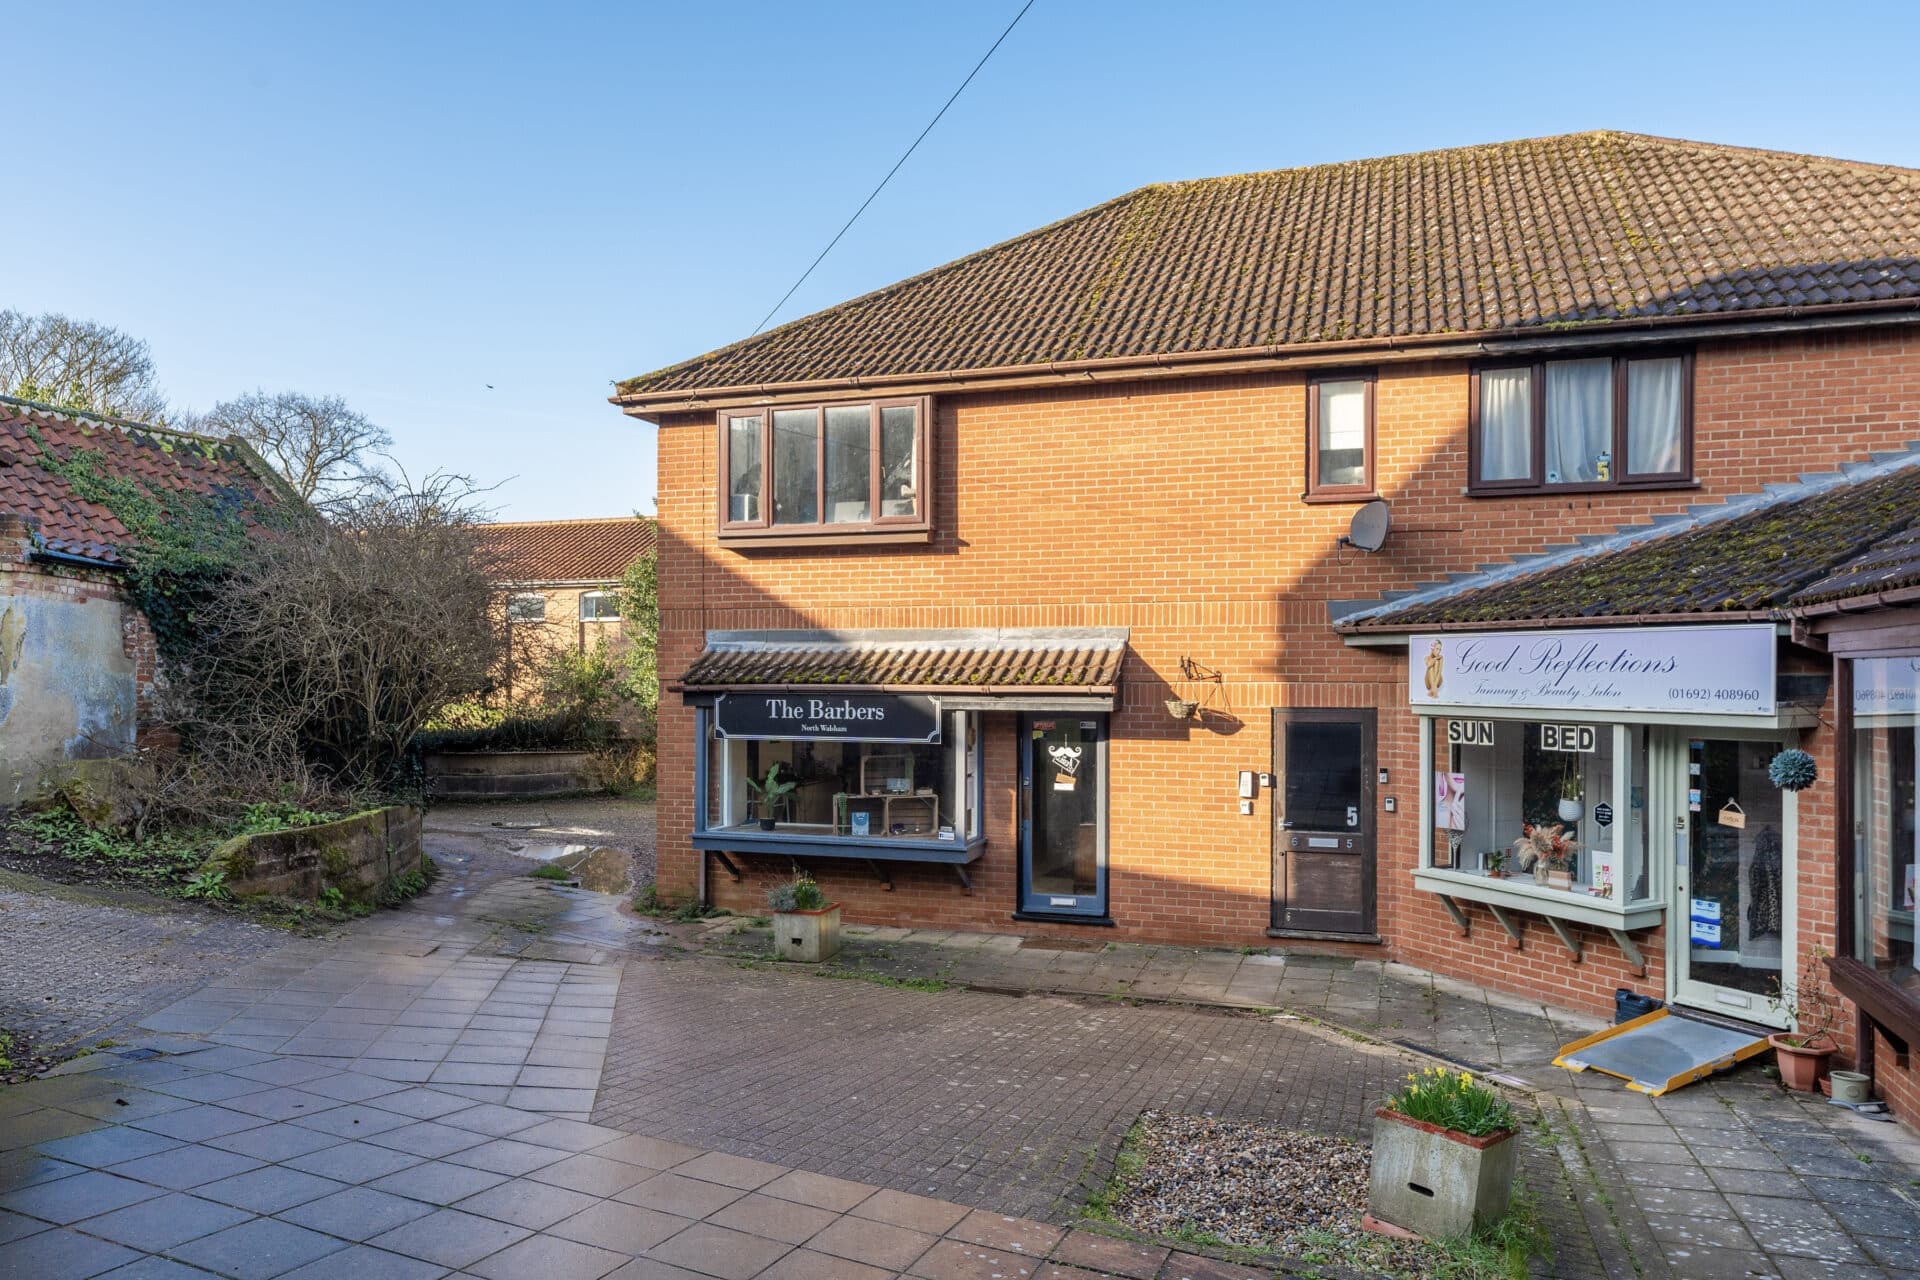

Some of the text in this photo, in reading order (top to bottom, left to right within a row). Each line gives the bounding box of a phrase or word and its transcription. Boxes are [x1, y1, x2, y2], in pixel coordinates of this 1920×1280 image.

[1455, 637, 1678, 687] Good Reflections
[1471, 678, 1518, 699] Tanning
[1531, 678, 1580, 703] Beauty
[1582, 680, 1623, 698] Salon
[1668, 688, 1760, 702] (01692) 408960
[766, 699, 885, 720] The Barbers
[801, 724, 847, 732] North Walsham
[1449, 721, 1594, 750] SUN BED
[1346, 806, 1358, 826] 5
[1346, 838, 1353, 848] 5
